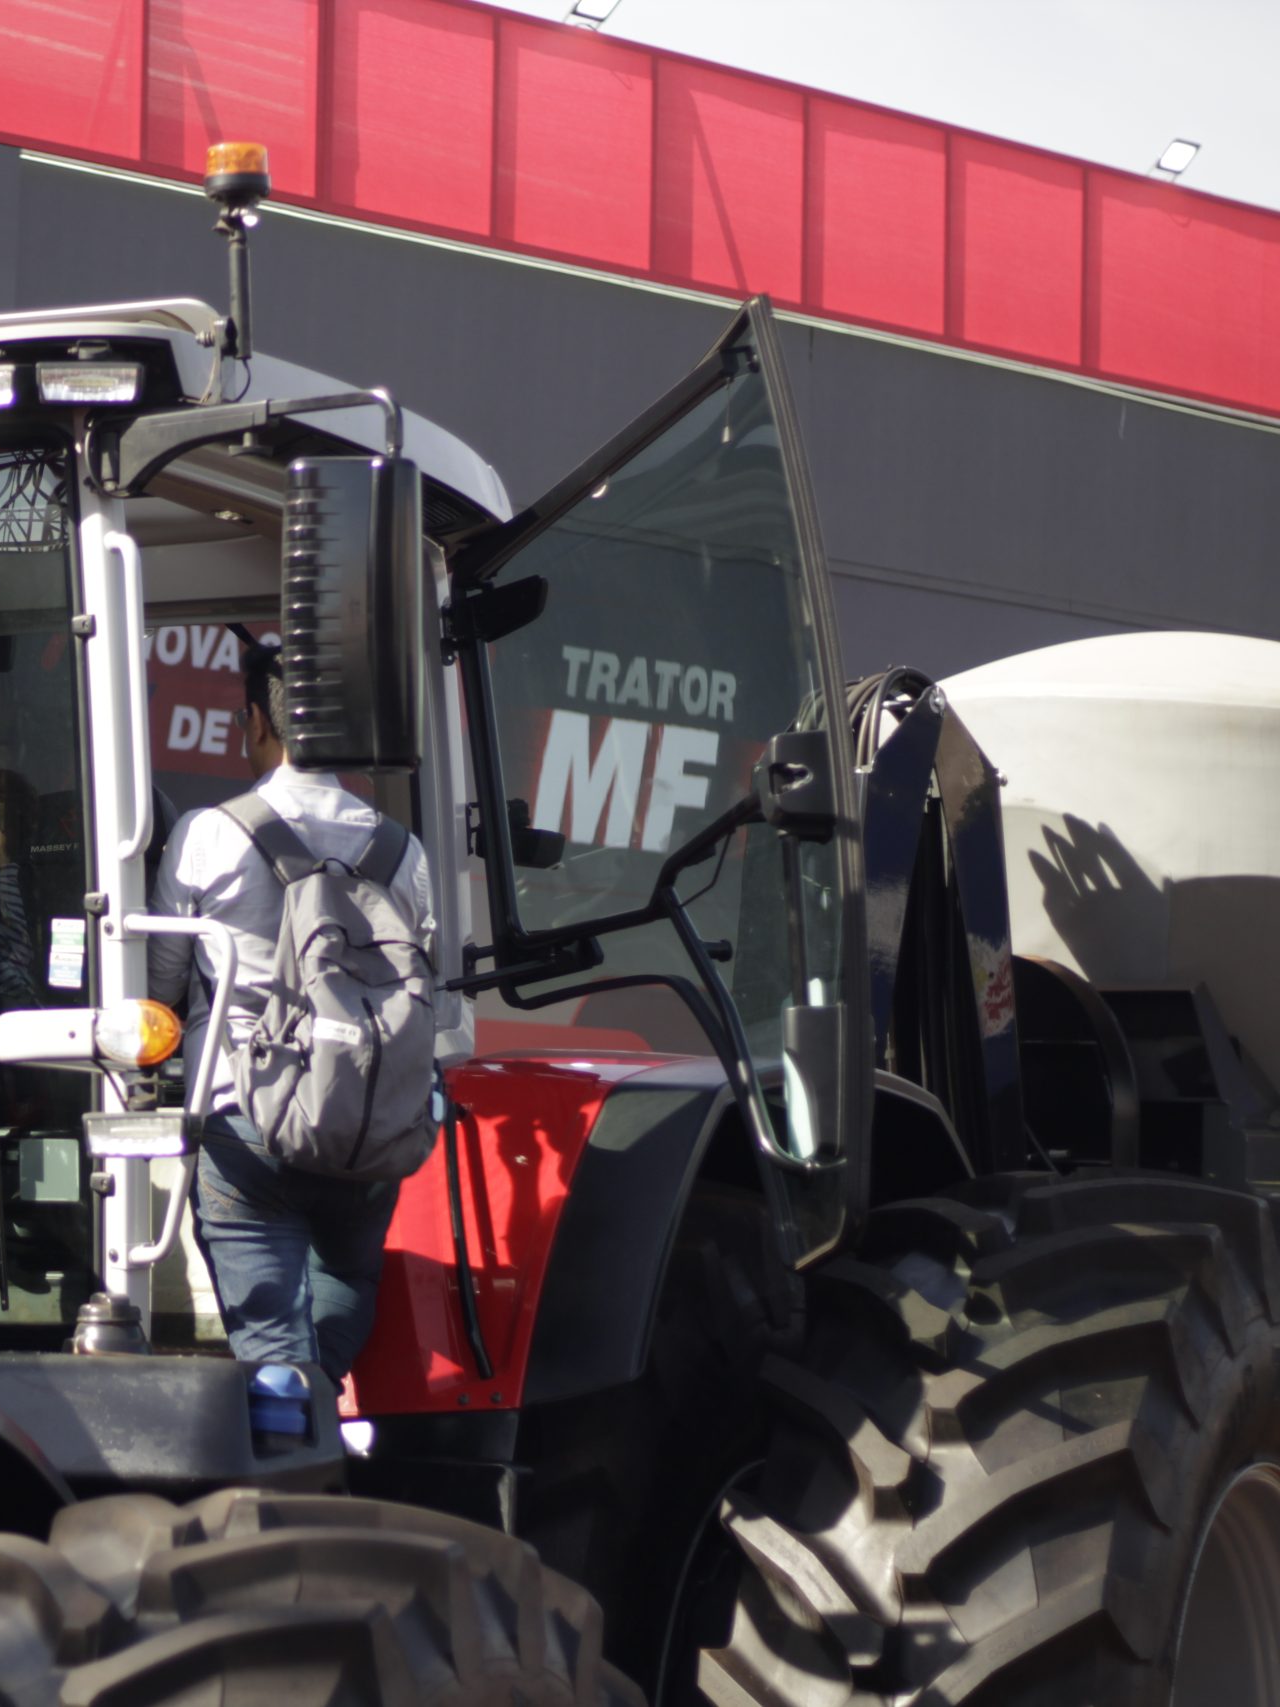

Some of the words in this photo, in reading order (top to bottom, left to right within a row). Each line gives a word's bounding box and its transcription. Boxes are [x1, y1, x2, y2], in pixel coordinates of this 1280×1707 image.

[144, 624, 241, 673] OVA
[562, 645, 737, 721] TRATOR
[167, 704, 232, 755] DE
[532, 709, 719, 851] MF
[30, 843, 72, 853] MASSEY
